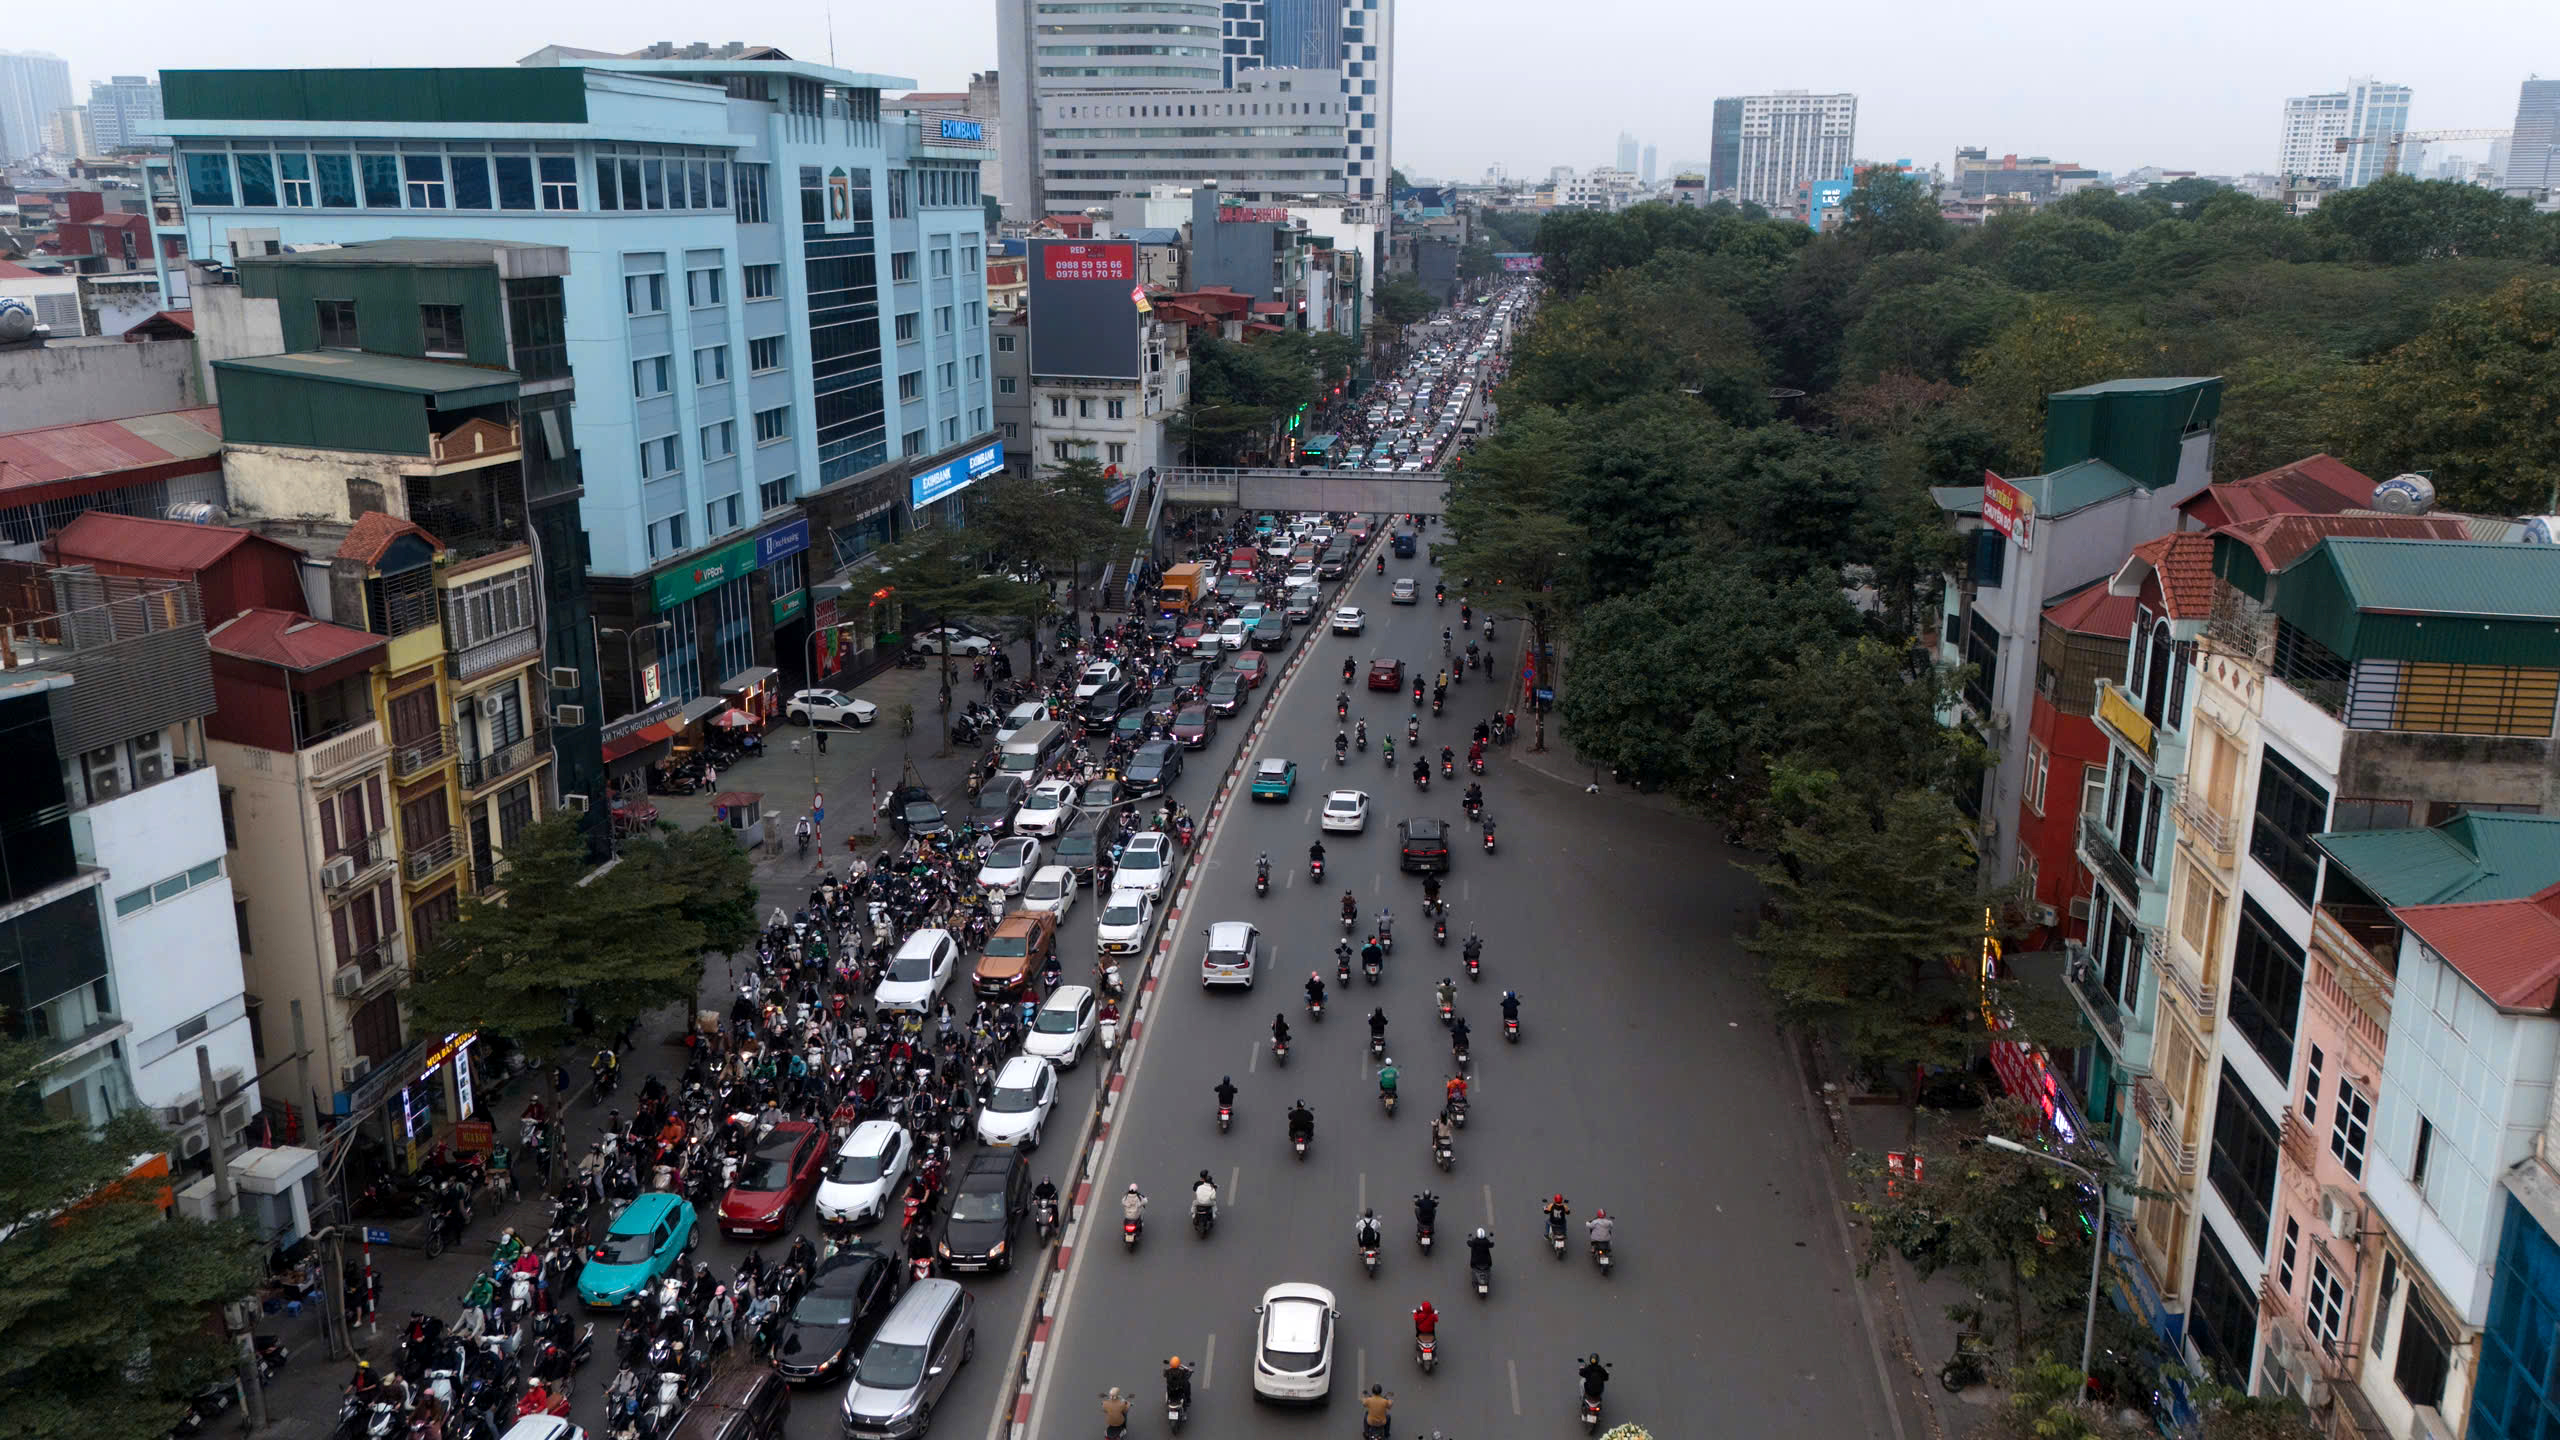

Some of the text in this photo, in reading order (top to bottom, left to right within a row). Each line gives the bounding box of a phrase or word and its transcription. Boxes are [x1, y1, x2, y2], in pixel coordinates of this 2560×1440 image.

[942, 120, 982, 140] EXIMBANK
[1822, 195, 1840, 203] LILY
[1070, 246, 1086, 254] RED
[1055, 261, 1122, 269] 0988 59 55 66
[1056, 270, 1122, 278] 0978 91 70 75
[969, 448, 995, 470] EXIMBANK
[922, 467, 952, 490] EXIMBANK
[703, 563, 724, 580] VPBank
[816, 598, 837, 618] SHINE
[426, 1052, 442, 1068] MUA
